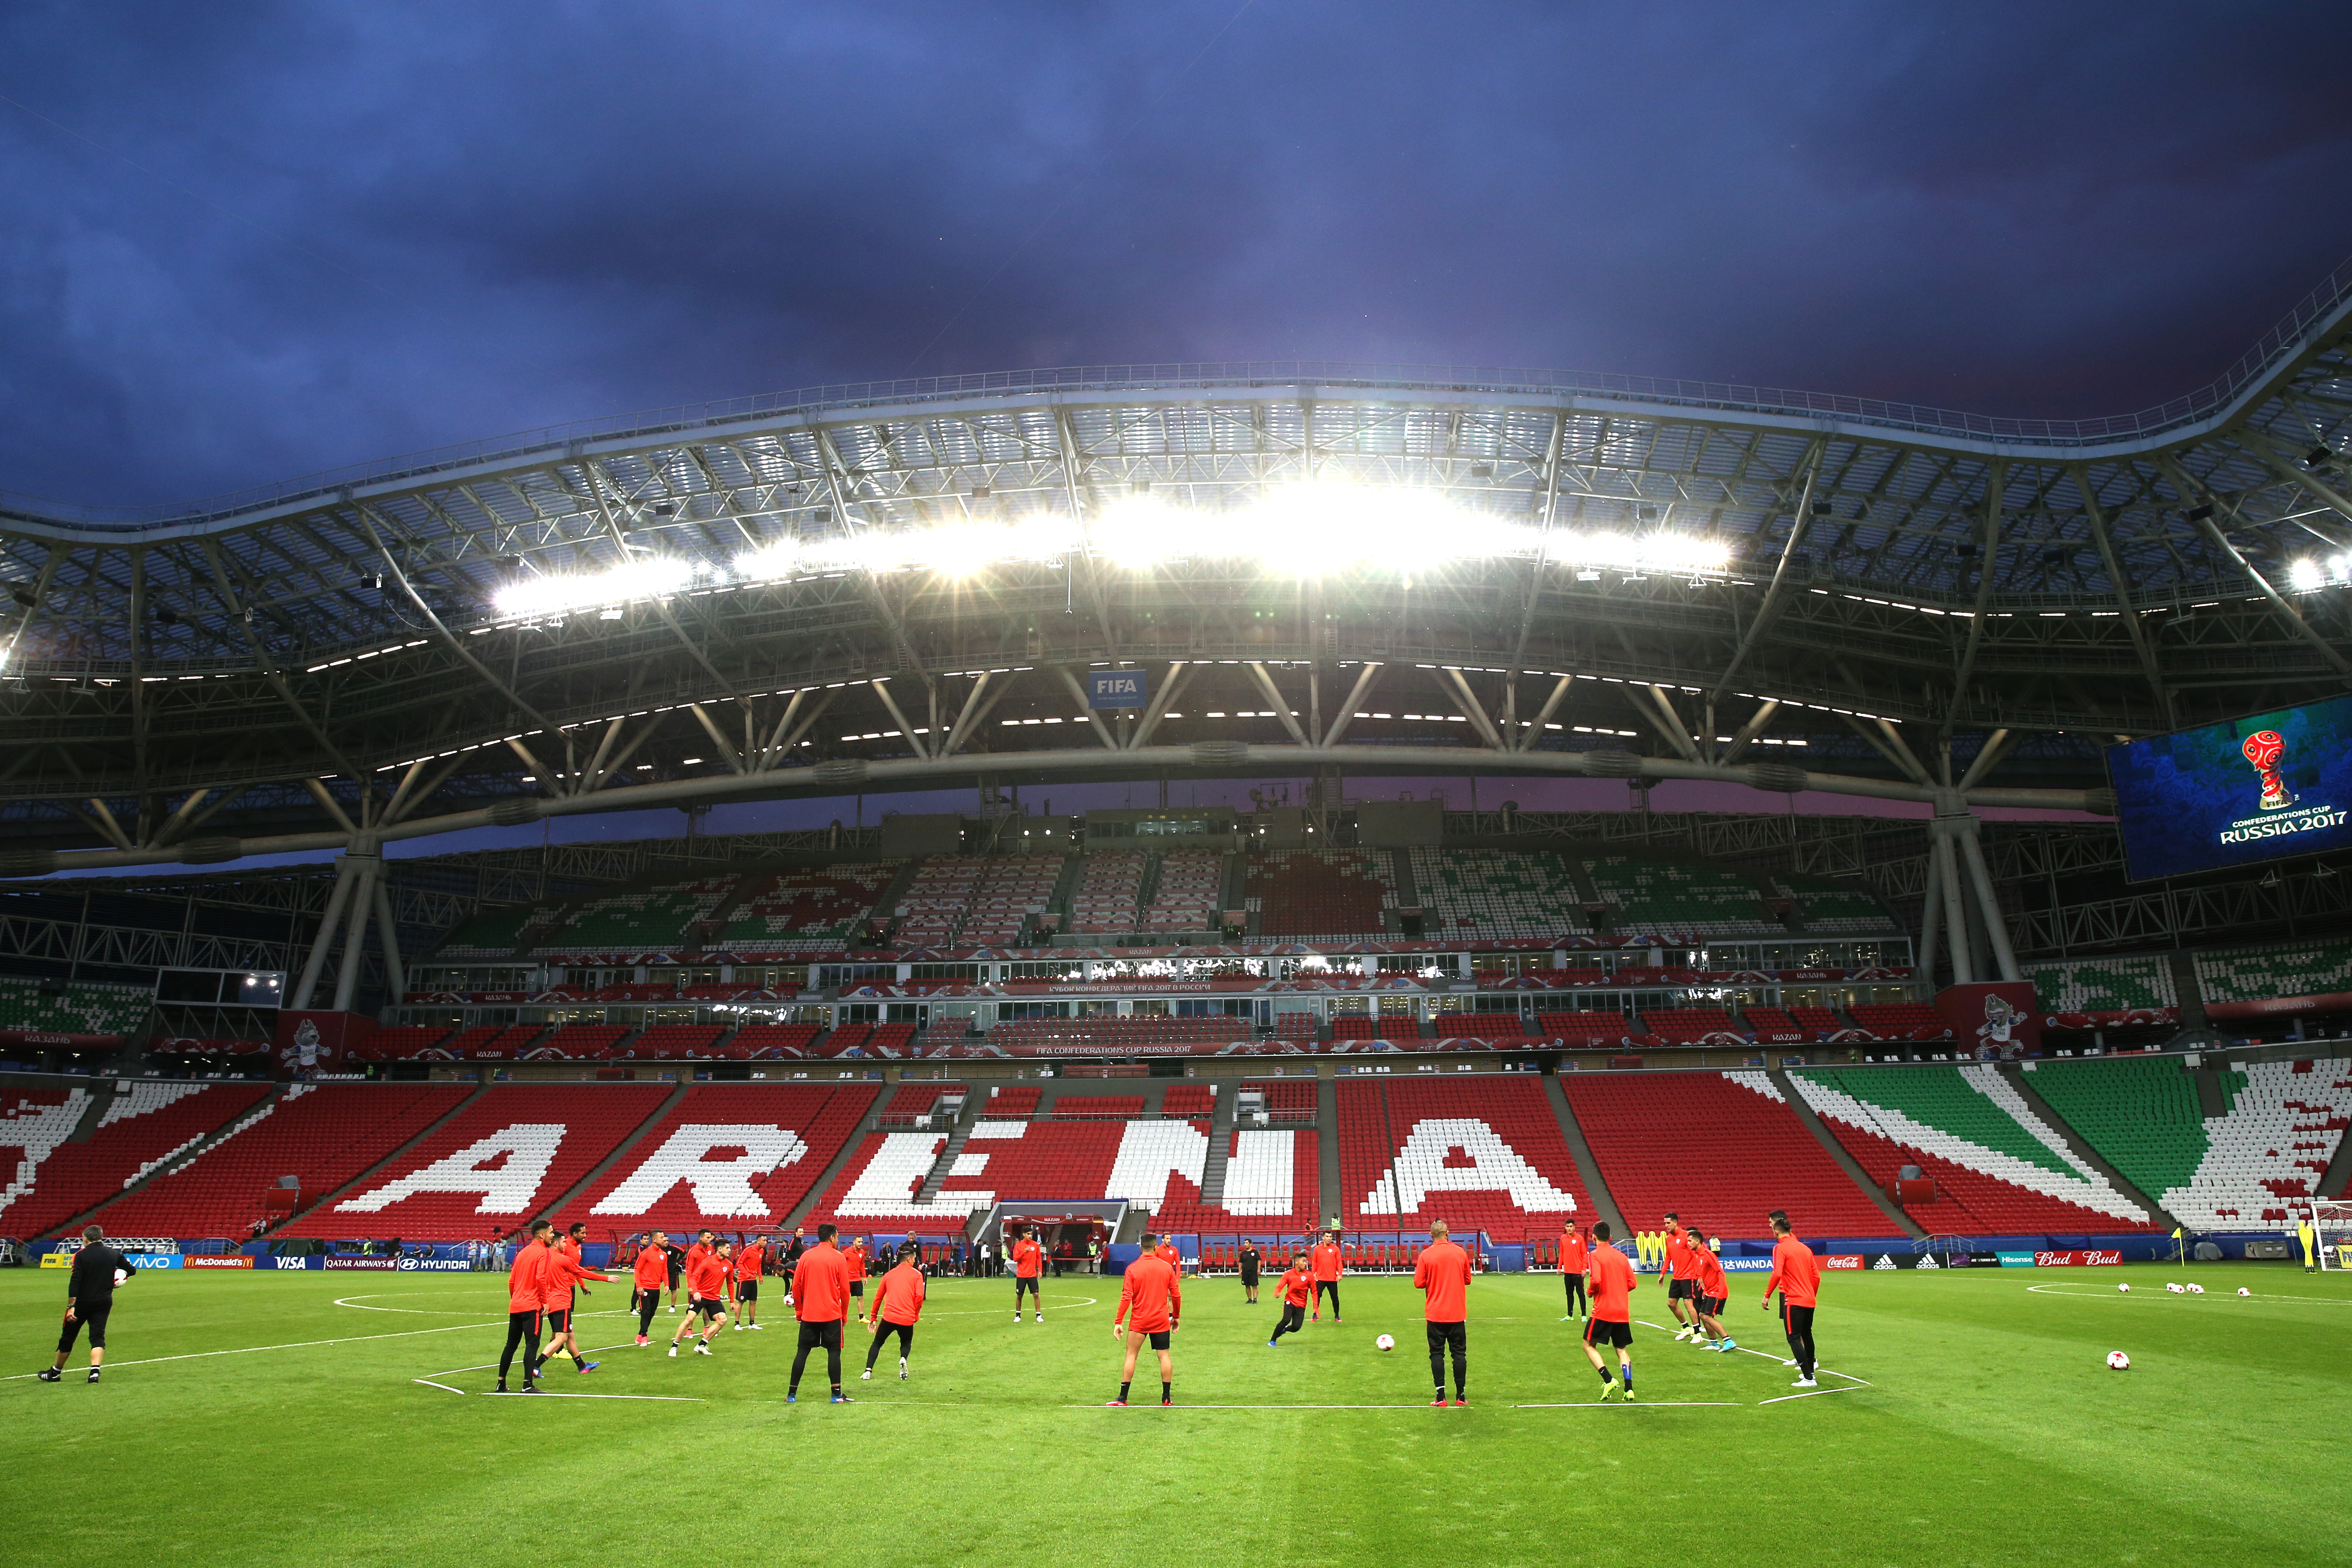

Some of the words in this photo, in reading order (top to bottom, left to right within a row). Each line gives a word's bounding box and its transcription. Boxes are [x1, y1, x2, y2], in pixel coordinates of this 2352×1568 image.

[1097, 679, 1137, 694] FIFA
[2266, 799, 2289, 808] FIFA
[2232, 808, 2311, 828] CONFEDERATIONS
[2312, 805, 2331, 813] CUP
[2220, 820, 2298, 844] RUSSIA
[2299, 811, 2347, 831] 2017
[24, 1035, 71, 1044] КАЗАНЬ
[333, 1118, 1576, 1217] ARENA
[126, 1254, 170, 1268] vivo
[195, 1258, 243, 1266] McDonald's
[274, 1256, 306, 1269] VISA
[326, 1259, 352, 1268] QATAR
[353, 1259, 387, 1268] AIRWAYS
[421, 1259, 470, 1269] HYUNDAI
[1827, 1256, 1859, 1269] Coca-Cola
[2034, 1251, 2072, 1266] Bud
[2082, 1251, 2119, 1265] Bud
